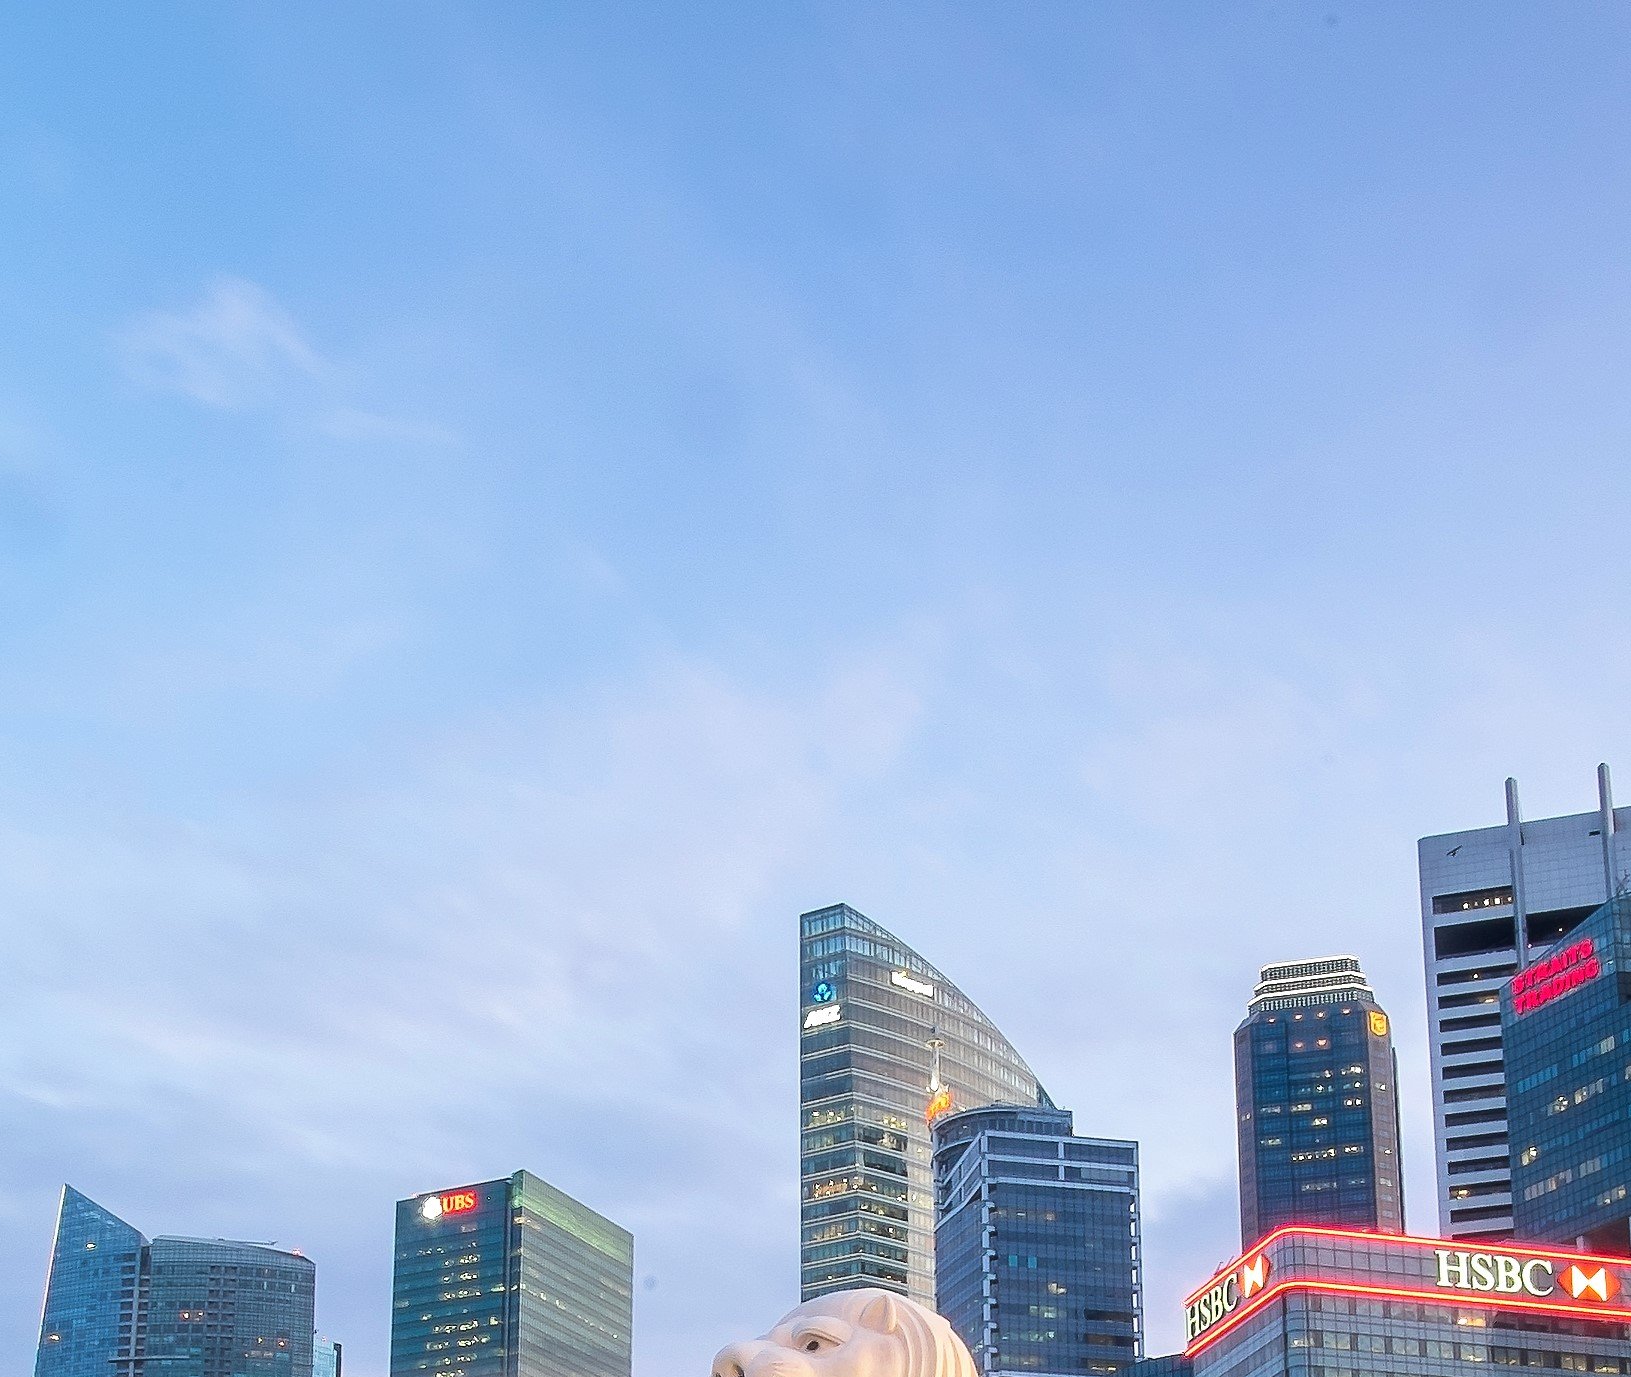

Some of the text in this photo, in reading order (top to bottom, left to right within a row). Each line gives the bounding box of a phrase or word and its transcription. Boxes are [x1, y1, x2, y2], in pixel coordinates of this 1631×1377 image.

[1512, 939, 1593, 995] STRAITS
[1514, 957, 1599, 1015] TRADING
[440, 1192, 474, 1212] UBS
[1434, 1250, 1554, 1298] HSBC
[1185, 1272, 1238, 1342] HSBC
